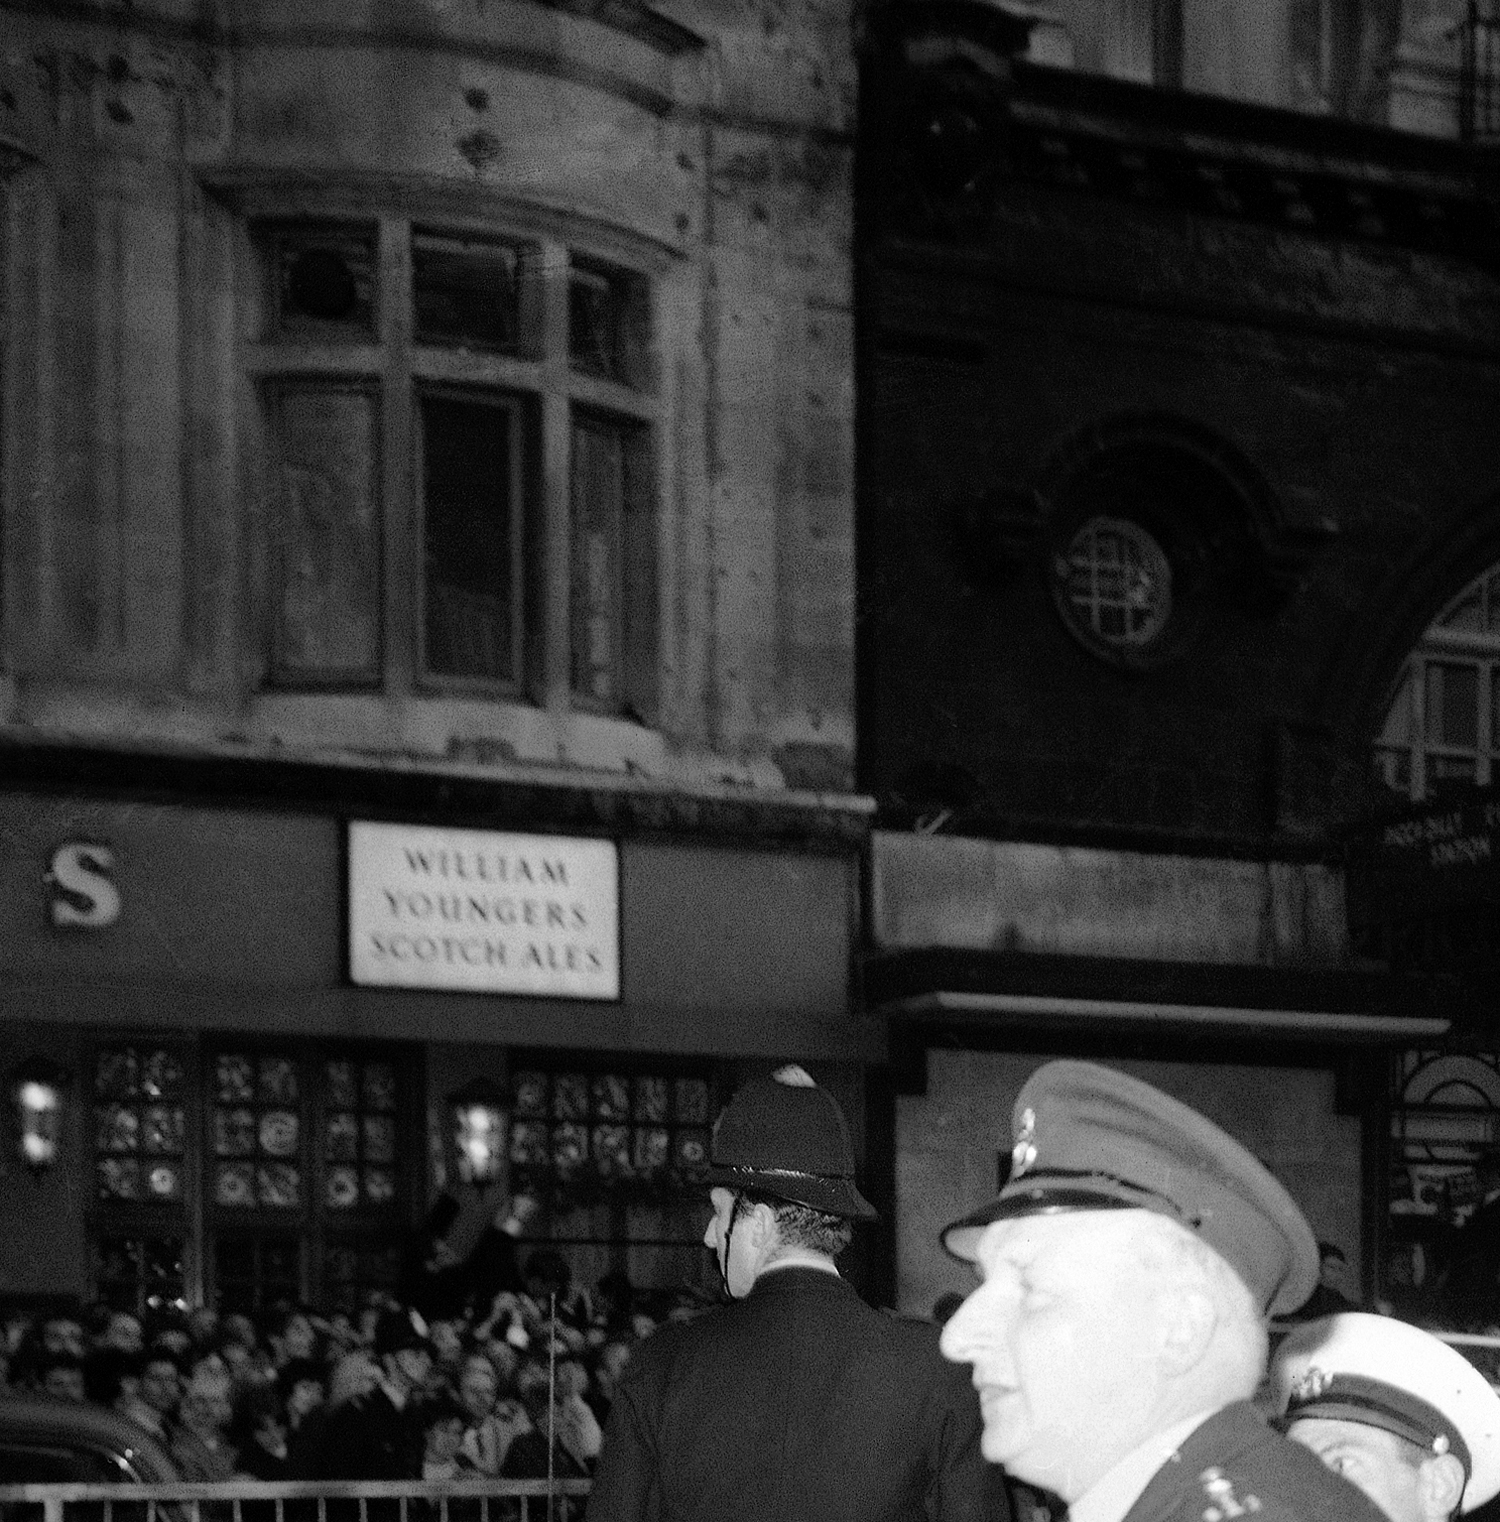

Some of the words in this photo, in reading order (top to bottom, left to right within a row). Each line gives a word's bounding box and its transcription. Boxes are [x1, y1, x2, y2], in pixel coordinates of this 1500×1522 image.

[402, 846, 570, 888] WILLIAM
[382, 886, 589, 932] YOUNGERS
[368, 929, 509, 970] SCOTCH
[519, 940, 604, 976] ALES
